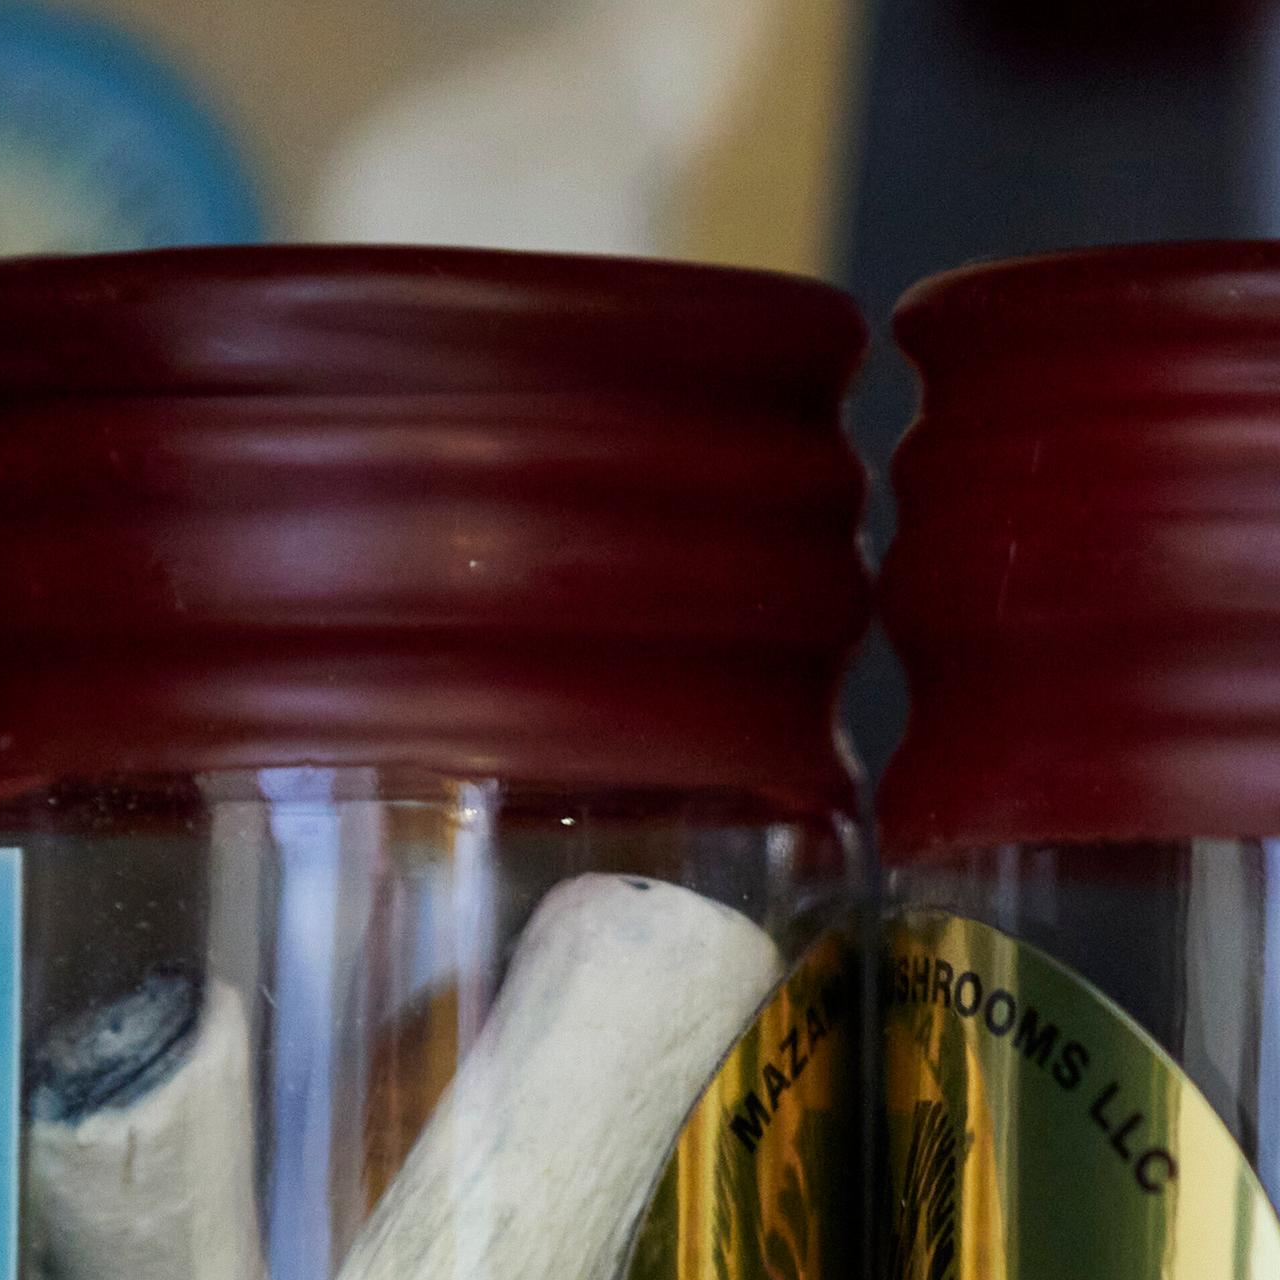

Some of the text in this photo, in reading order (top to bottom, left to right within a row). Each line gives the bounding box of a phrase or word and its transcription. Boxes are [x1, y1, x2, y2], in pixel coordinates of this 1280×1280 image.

[729, 957, 1180, 1195] MAZA SHROOMS LLC
